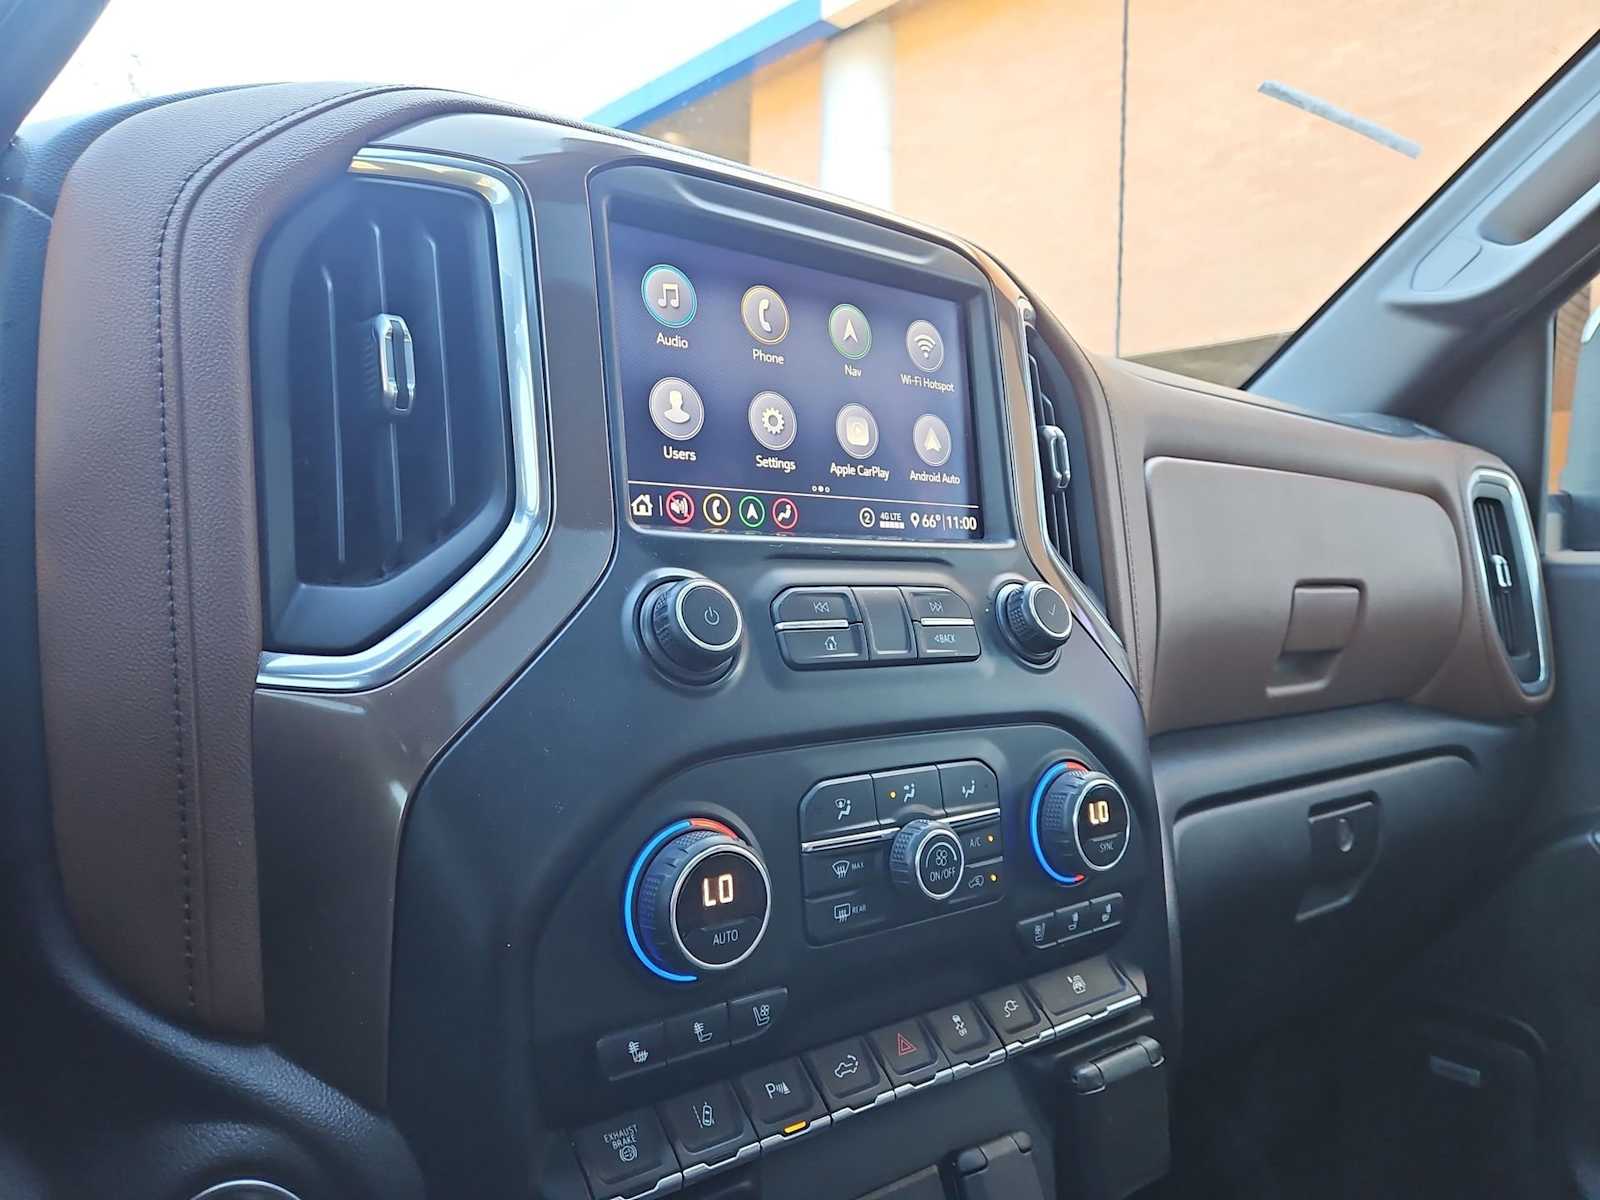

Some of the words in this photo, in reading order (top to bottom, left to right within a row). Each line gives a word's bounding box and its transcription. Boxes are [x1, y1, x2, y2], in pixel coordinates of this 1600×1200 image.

[656, 332, 688, 349] Audio
[752, 349, 785, 364] Phone
[844, 364, 862, 378] Nav
[900, 374, 921, 387] Wi-Fi
[923, 377, 955, 393] Hotspot
[663, 446, 696, 461] Users
[755, 455, 796, 472] Settings
[830, 462, 856, 477] Apple
[857, 465, 890, 480] CarPlay
[910, 470, 941, 483] Android
[942, 473, 961, 485] Auto
[880, 512, 889, 520] 4G
[890, 512, 902, 521] LTE
[922, 514, 941, 529] 66°
[946, 515, 978, 530] 11:00
[939, 633, 956, 643] BACK
[1088, 800, 1110, 824] LO
[969, 838, 982, 848] A/C
[852, 861, 865, 871] MAX
[929, 868, 957, 882] ON/OFF
[703, 873, 734, 907] LO
[852, 903, 867, 914] REAR
[712, 929, 739, 946] AUTO
[603, 1124, 638, 1144] EXHAUST
[612, 1134, 637, 1150] BRAKE
